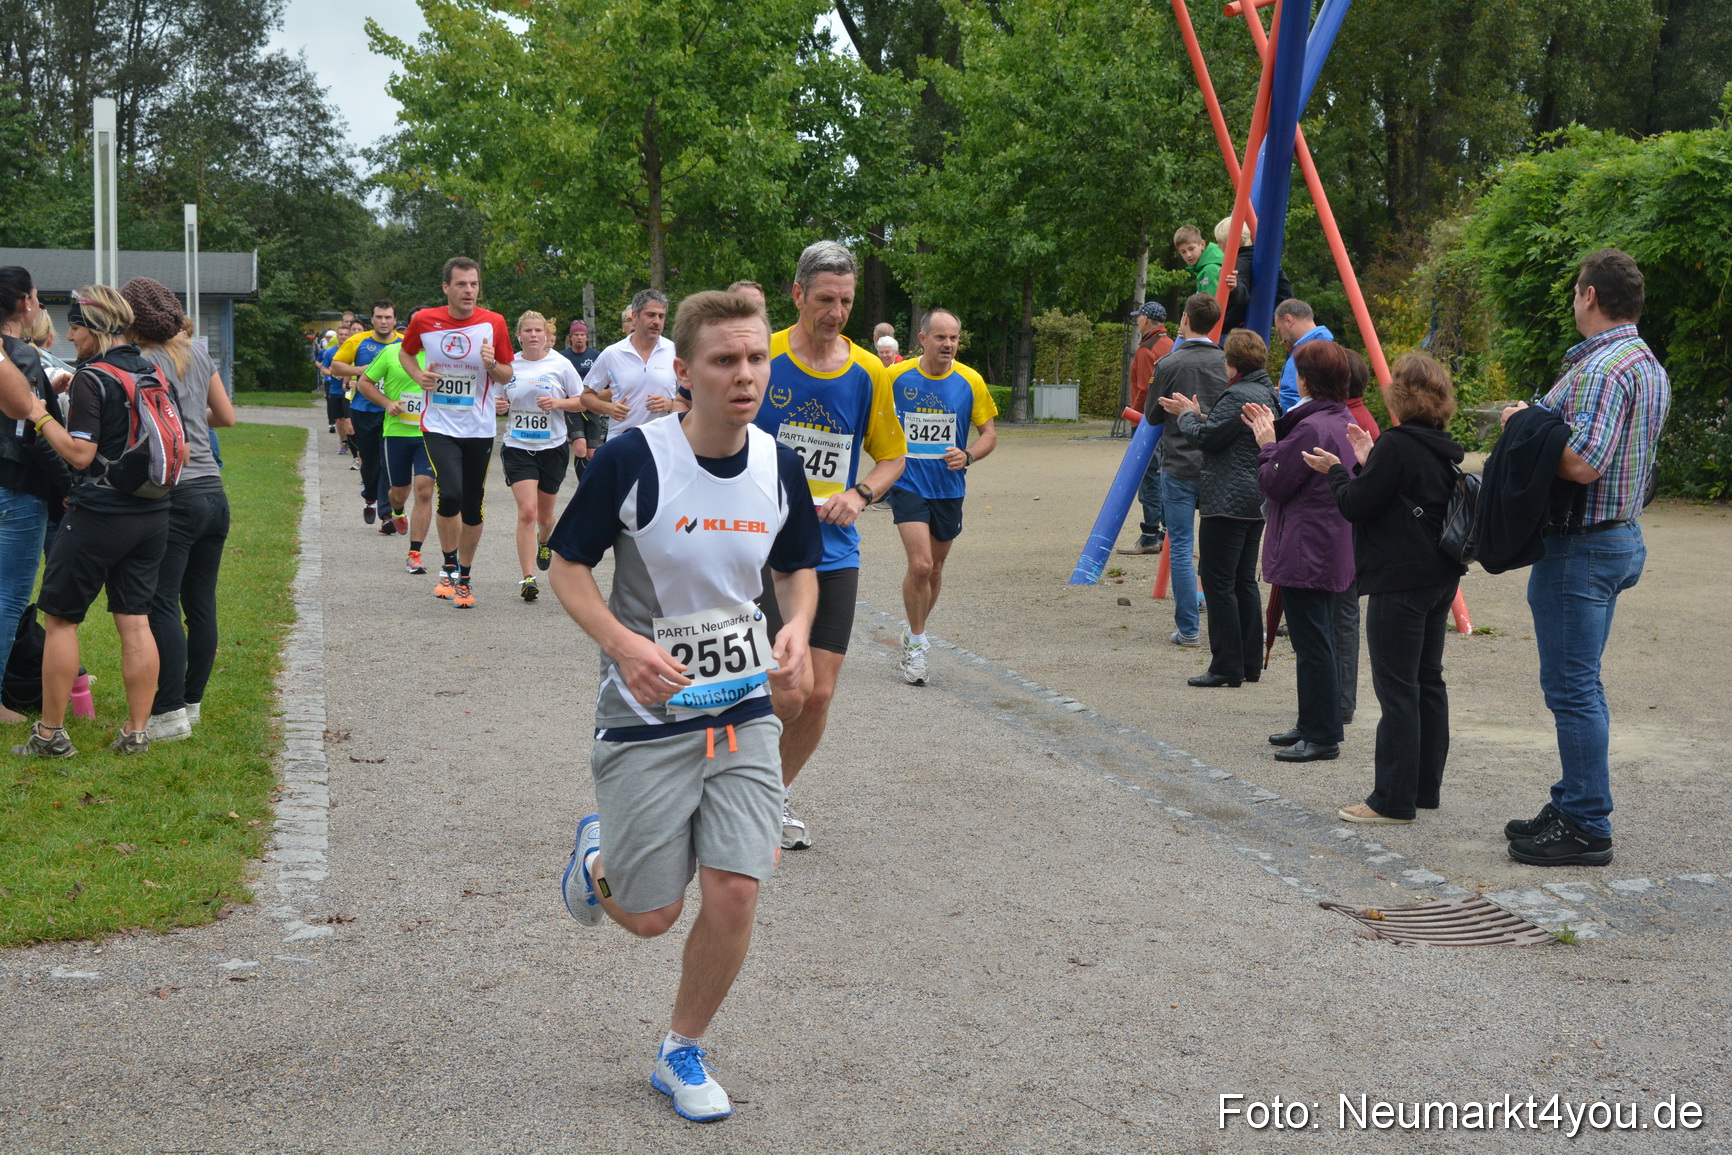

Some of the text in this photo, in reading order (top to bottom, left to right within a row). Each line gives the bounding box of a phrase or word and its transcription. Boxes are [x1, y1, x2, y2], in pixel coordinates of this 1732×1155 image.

[436, 379, 471, 395] 2901
[515, 414, 548, 430] 2168
[779, 431, 844, 449] PARTL Neumarkt
[909, 423, 951, 442] 3424
[703, 518, 770, 534] KLEBL
[657, 614, 750, 639] PARTL Neumarkt
[670, 627, 762, 680] 2551
